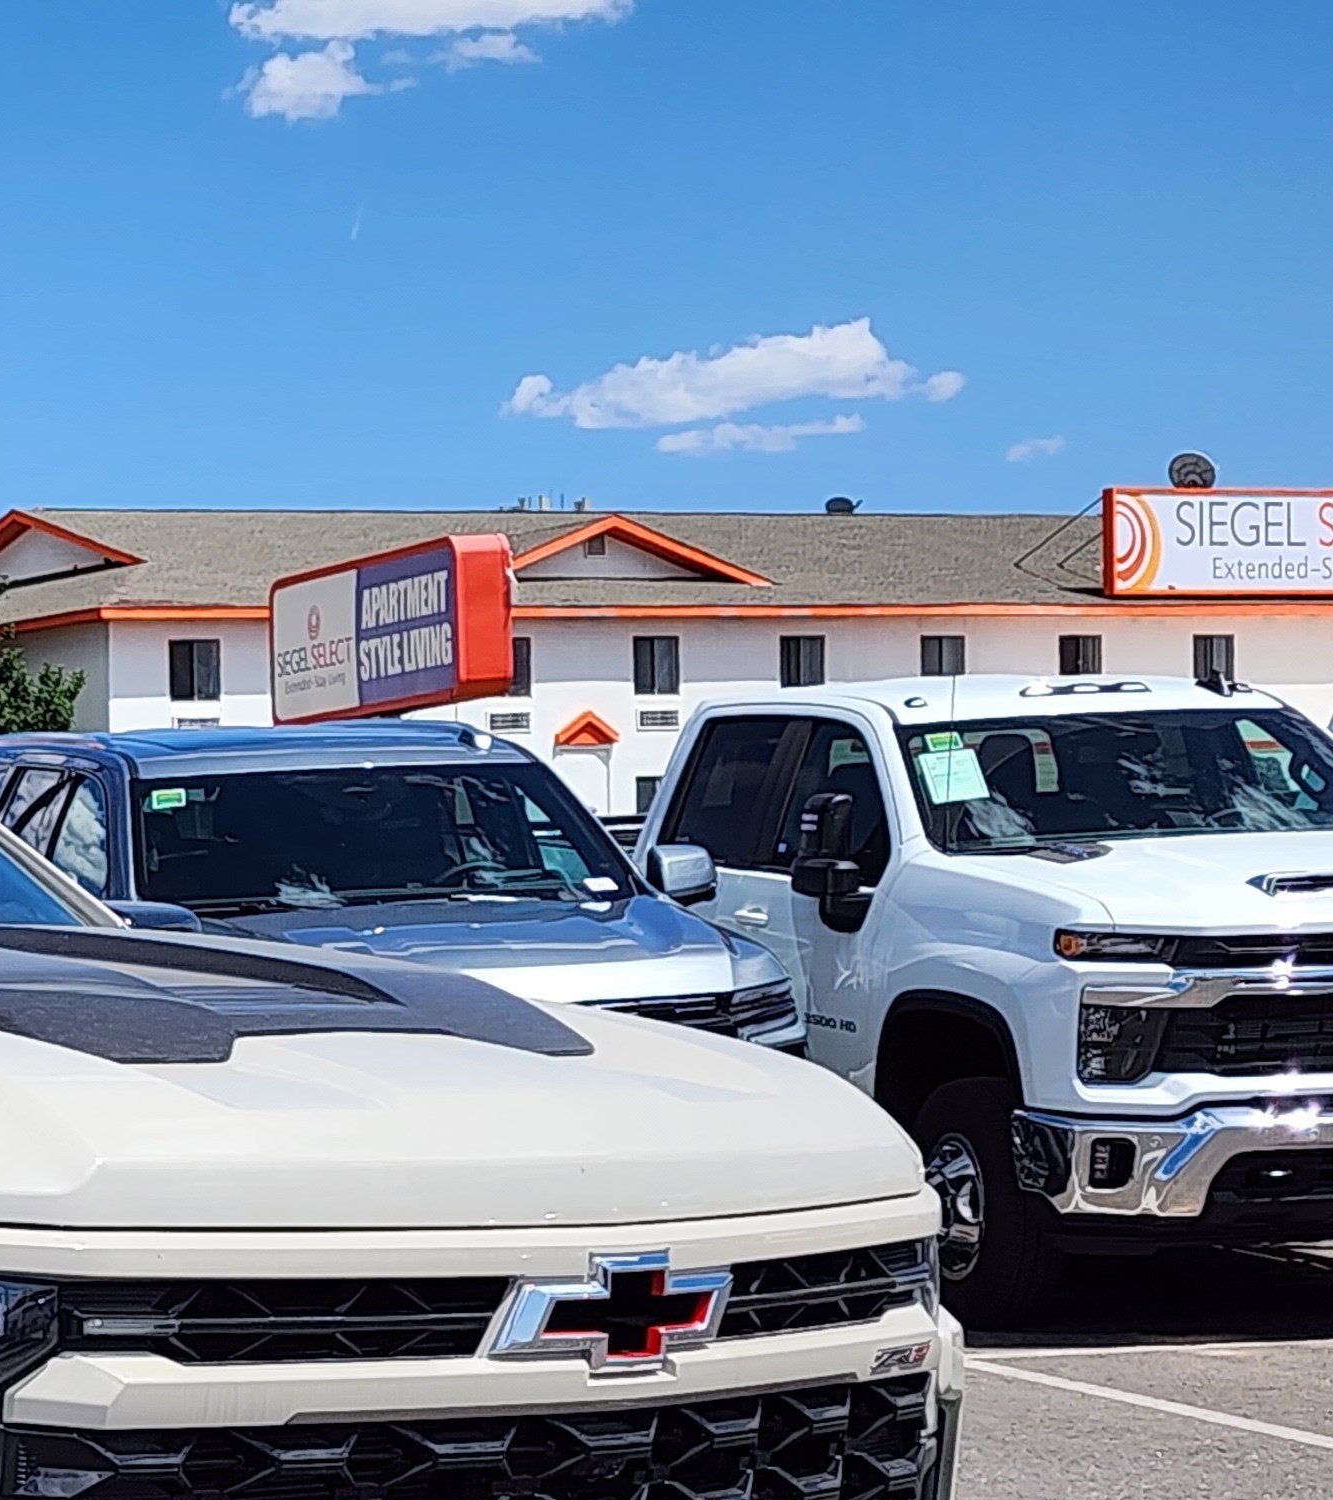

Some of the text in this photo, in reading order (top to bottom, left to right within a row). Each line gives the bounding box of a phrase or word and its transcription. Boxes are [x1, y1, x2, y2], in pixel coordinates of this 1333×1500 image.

[1176, 501, 1306, 547] SIEGEL
[361, 570, 449, 630] APARTMENT
[312, 637, 353, 670] SELECT
[359, 621, 453, 682] STYLE LIVING
[839, 1018, 857, 1034] HD
